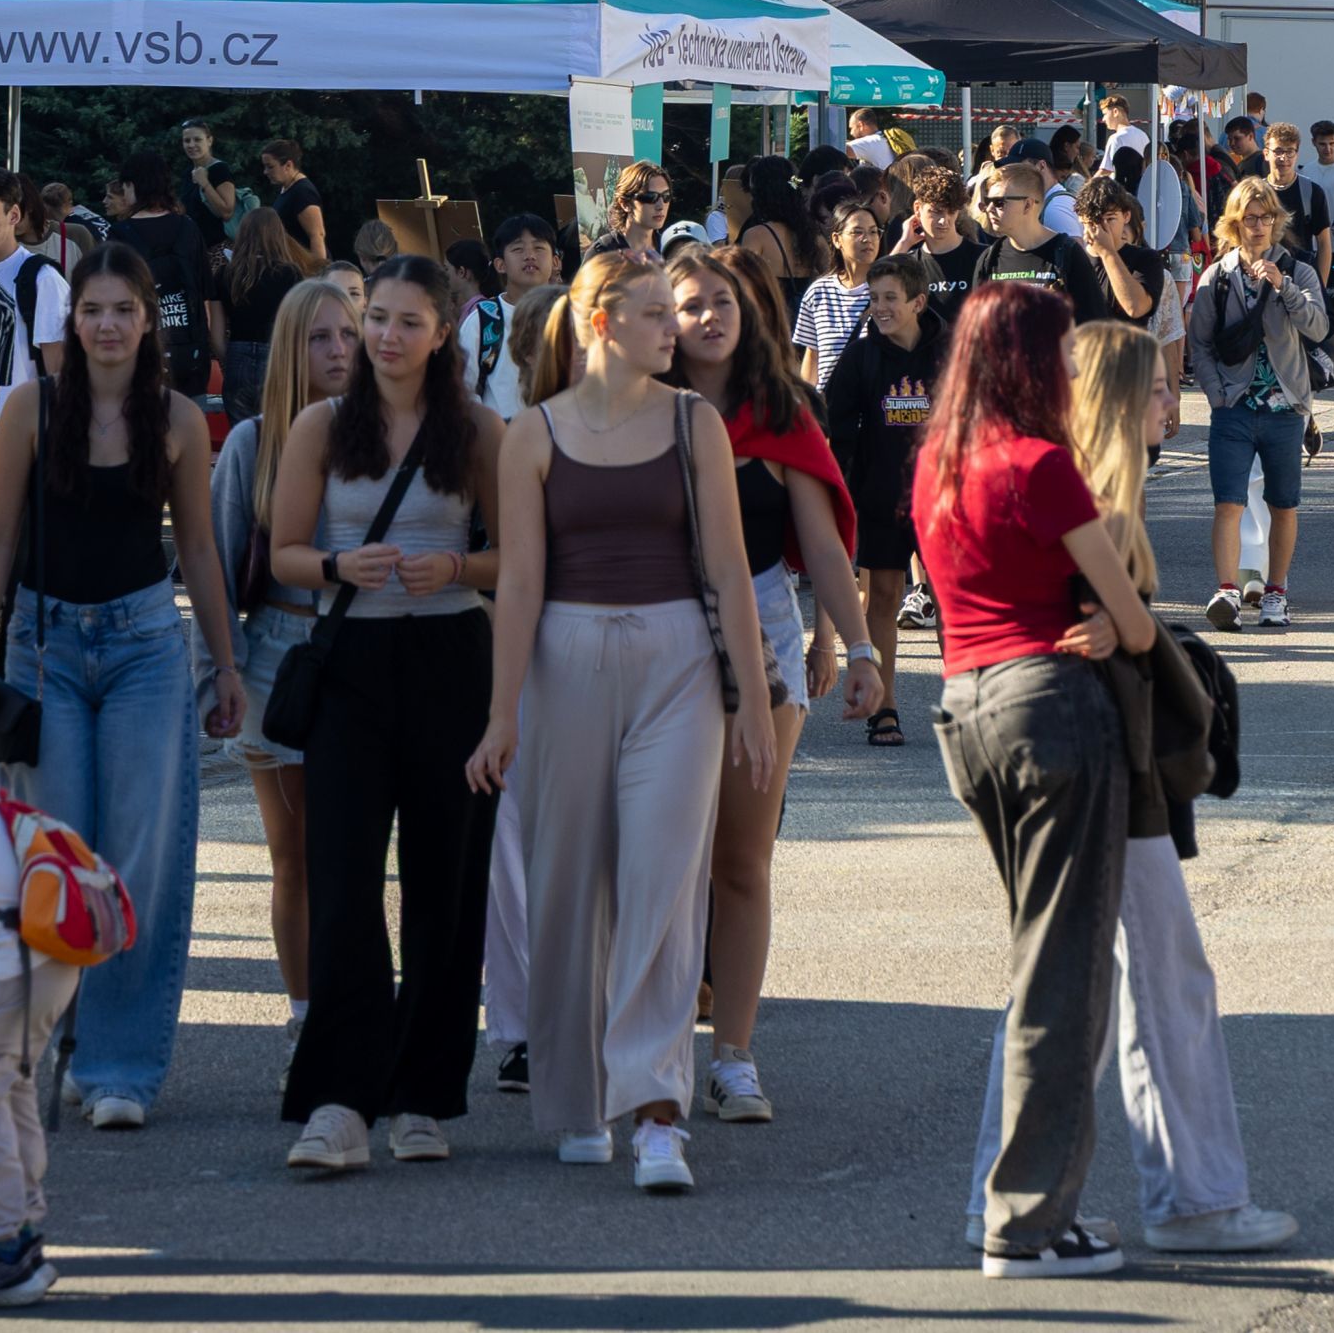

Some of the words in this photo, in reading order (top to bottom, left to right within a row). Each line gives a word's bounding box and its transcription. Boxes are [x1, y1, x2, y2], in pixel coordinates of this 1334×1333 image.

[678, 23, 727, 69] Technická
[727, 32, 771, 72] univerzita
[771, 33, 808, 76] Ostrava
[928, 281, 967, 292] OKYO
[160, 304, 187, 316] NIKE
[161, 314, 189, 328] NIKE
